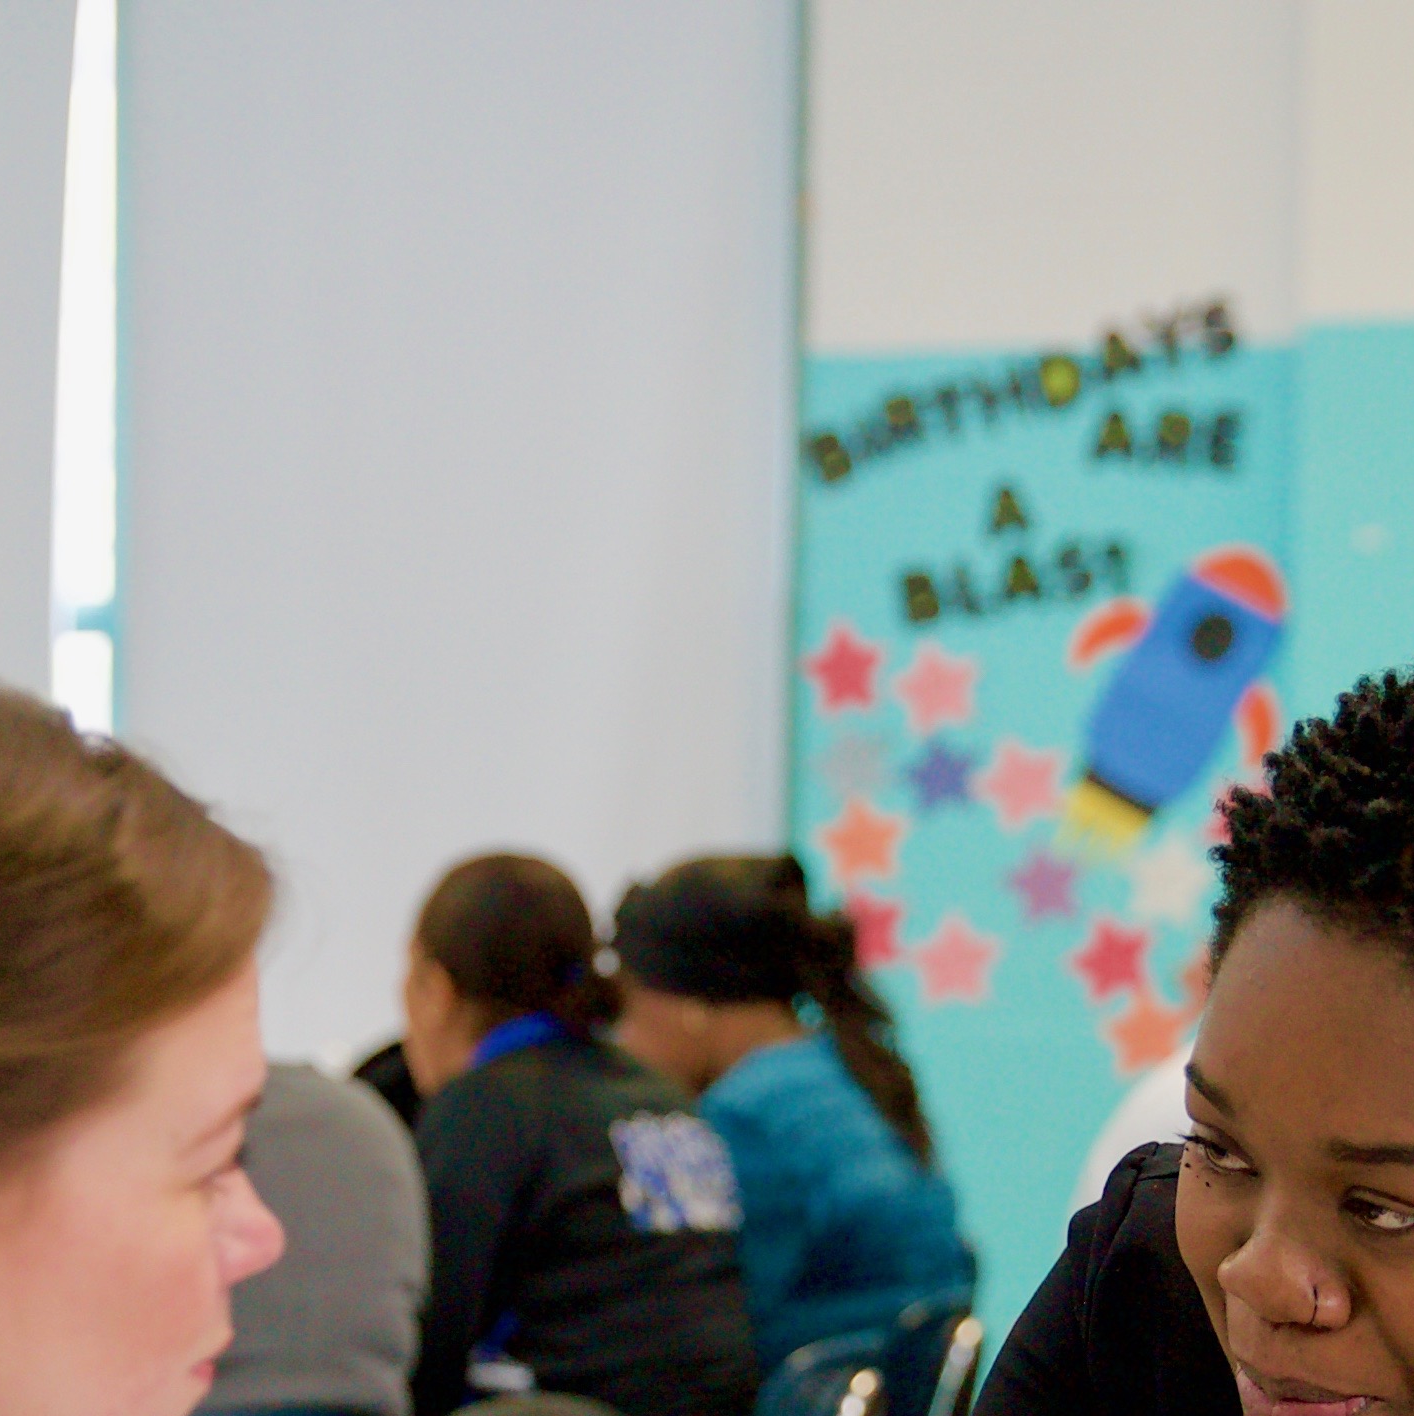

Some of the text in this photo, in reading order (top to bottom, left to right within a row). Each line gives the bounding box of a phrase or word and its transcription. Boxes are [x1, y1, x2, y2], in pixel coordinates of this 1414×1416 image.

[803, 302, 1239, 482] BIRTHDAYS
[1093, 410, 1239, 470] ARE
[991, 488, 1028, 534] A
[902, 543, 1130, 622] BLAST
